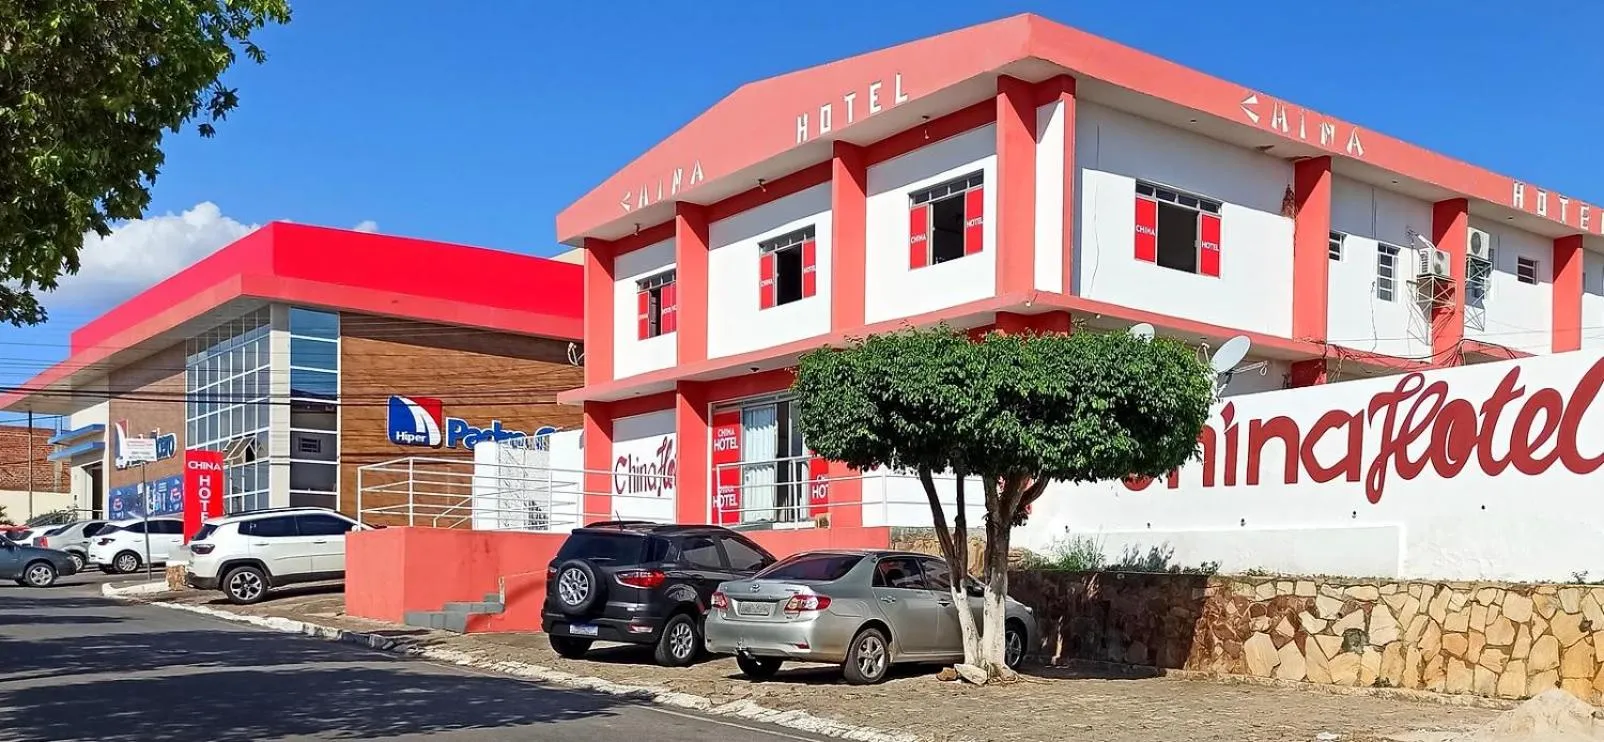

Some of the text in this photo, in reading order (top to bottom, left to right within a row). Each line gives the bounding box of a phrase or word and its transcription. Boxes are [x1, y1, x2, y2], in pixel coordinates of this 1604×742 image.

[1240, 95, 1365, 156] CHINA
[620, 72, 908, 212] CHINA HOTEL
[910, 216, 984, 244] CHINA HOTEL
[1135, 224, 1220, 252] CHINA HOTEL
[395, 431, 427, 443] Hiper
[714, 437, 738, 452] HOTEL
[718, 428, 735, 437] CHINA
[188, 461, 221, 471] CHINA
[614, 453, 657, 495] China
[198, 475, 212, 527] HOTE
[713, 493, 738, 508] HOTEL
